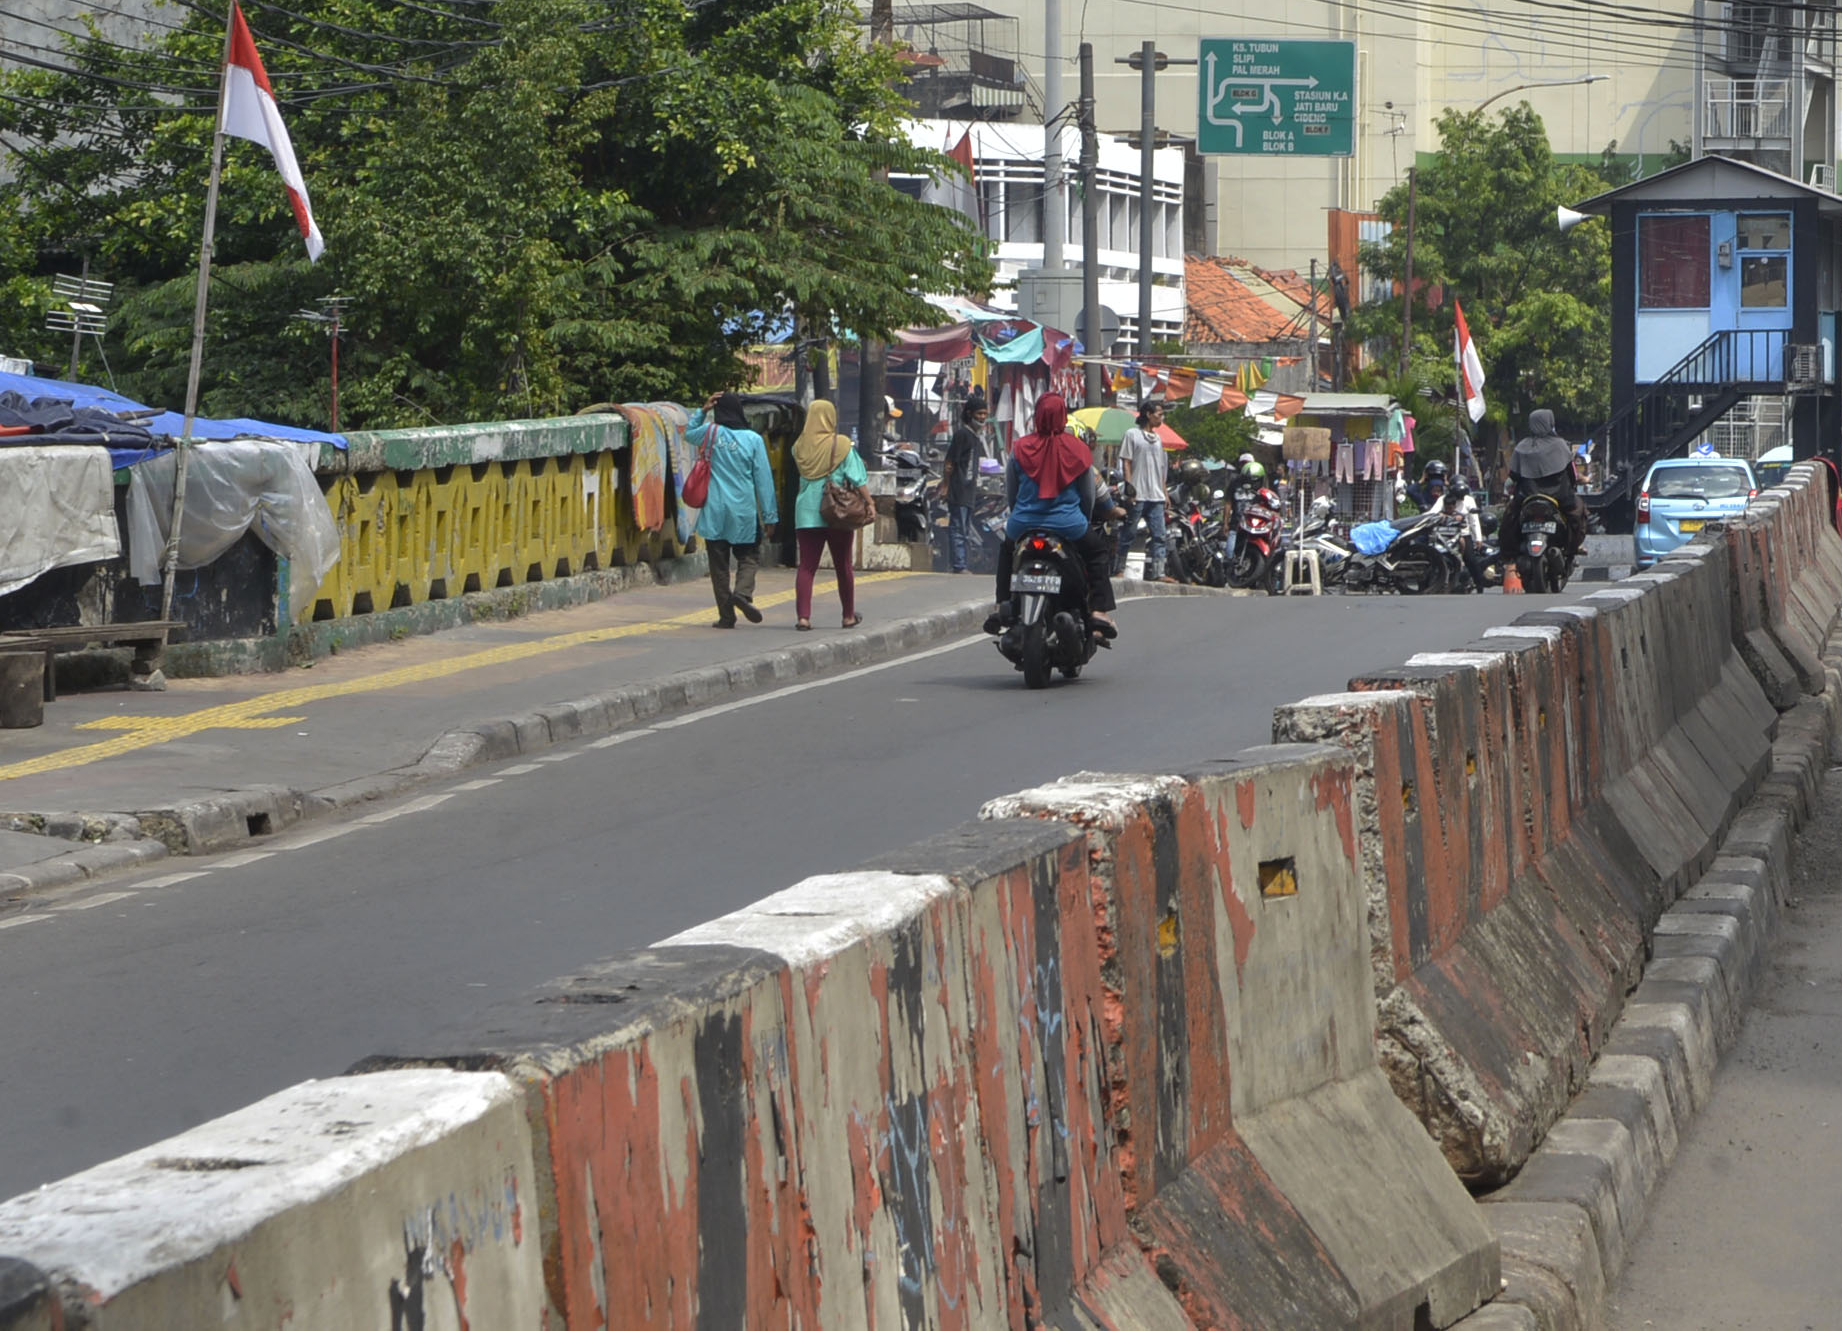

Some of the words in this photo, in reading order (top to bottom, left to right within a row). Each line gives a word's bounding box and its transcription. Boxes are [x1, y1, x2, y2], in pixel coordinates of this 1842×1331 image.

[1249, 43, 1279, 53] TUBUN
[1233, 54, 1255, 63] SLIPI
[1232, 65, 1248, 74] PAL
[1250, 66, 1280, 75] MERAH
[1232, 89, 1249, 97] BLOK
[1294, 91, 1331, 100] STASIUN
[1294, 102, 1312, 111] JATI
[1315, 102, 1338, 111] BARU
[1294, 113, 1326, 123] CIDENG
[1305, 125, 1322, 134] BLOK
[1263, 130, 1286, 140] BLOK
[1288, 131, 1294, 140] A
[1263, 141, 1286, 151] BLOK
[1288, 142, 1294, 151] B
